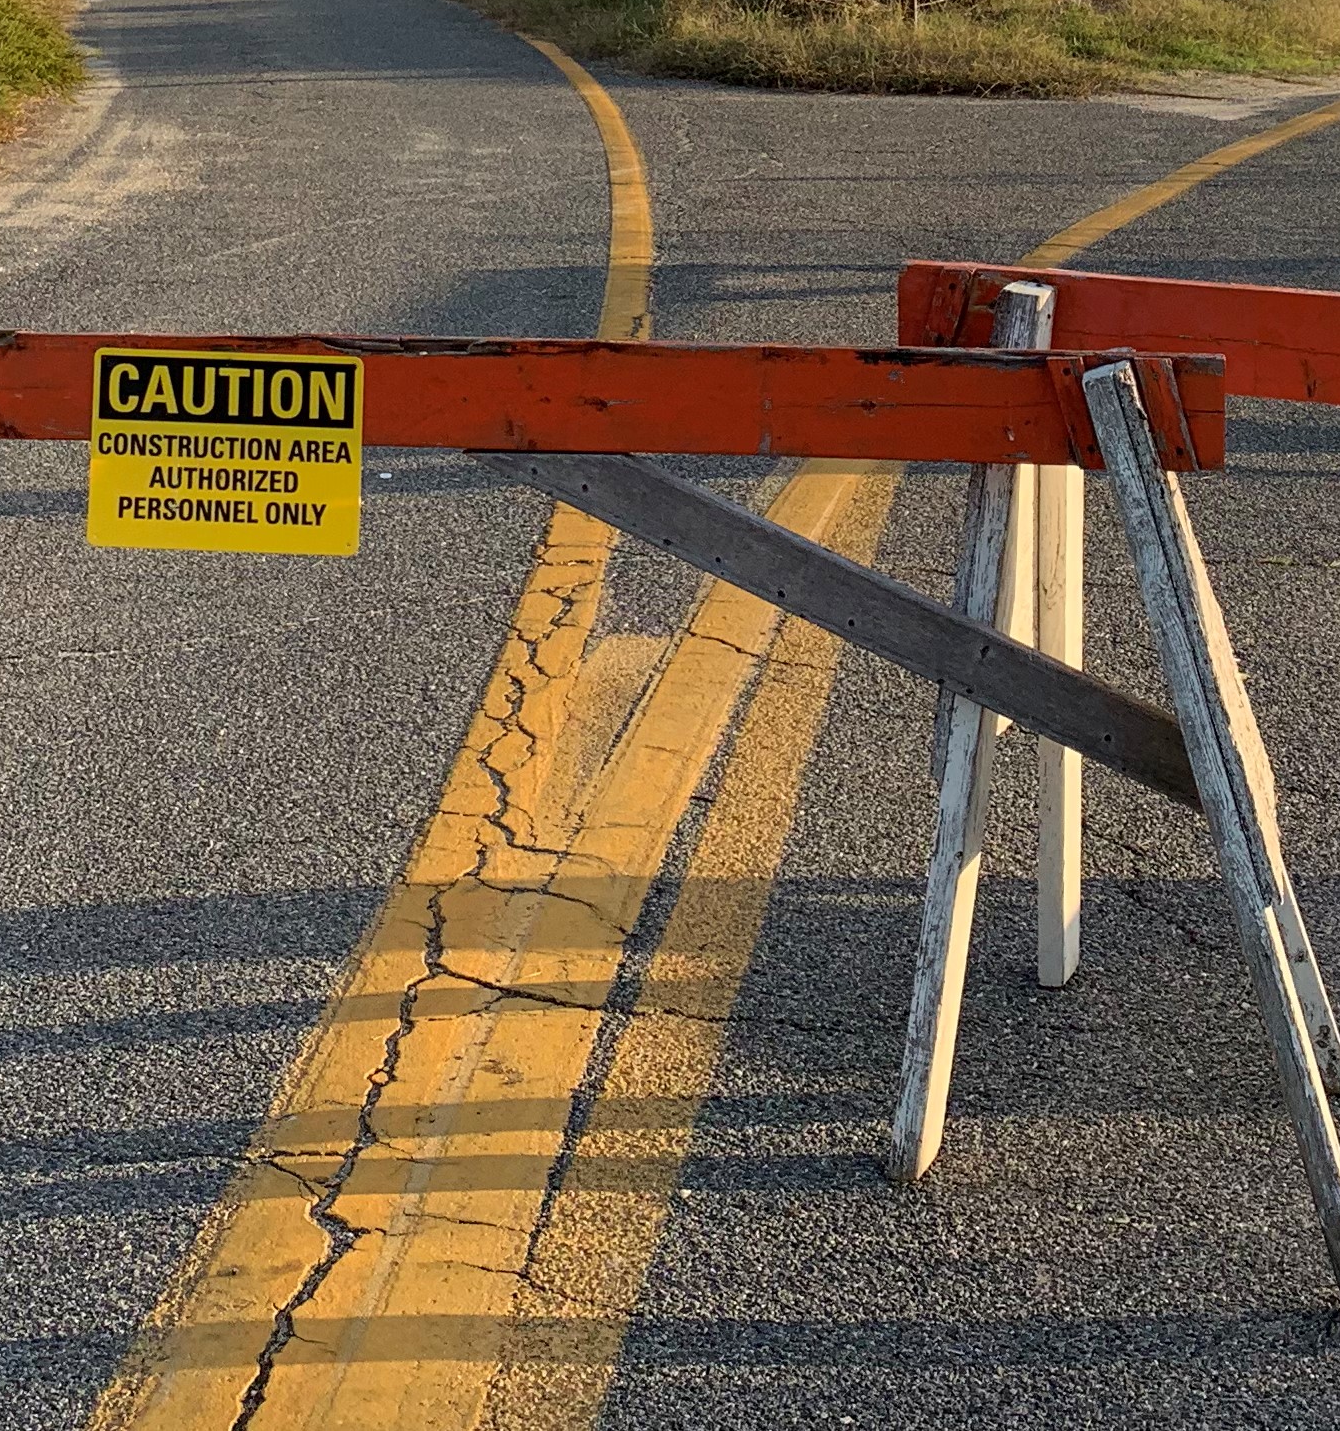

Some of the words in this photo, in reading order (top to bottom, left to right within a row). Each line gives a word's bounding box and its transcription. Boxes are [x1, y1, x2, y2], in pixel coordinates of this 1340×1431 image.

[108, 363, 346, 421] CAUTION
[98, 432, 281, 462] CONSTRUCTION
[288, 439, 352, 464] AREA
[149, 466, 298, 493] AUTHORIZED
[118, 497, 258, 524] PERSONNEL
[265, 502, 327, 526] ONLY
